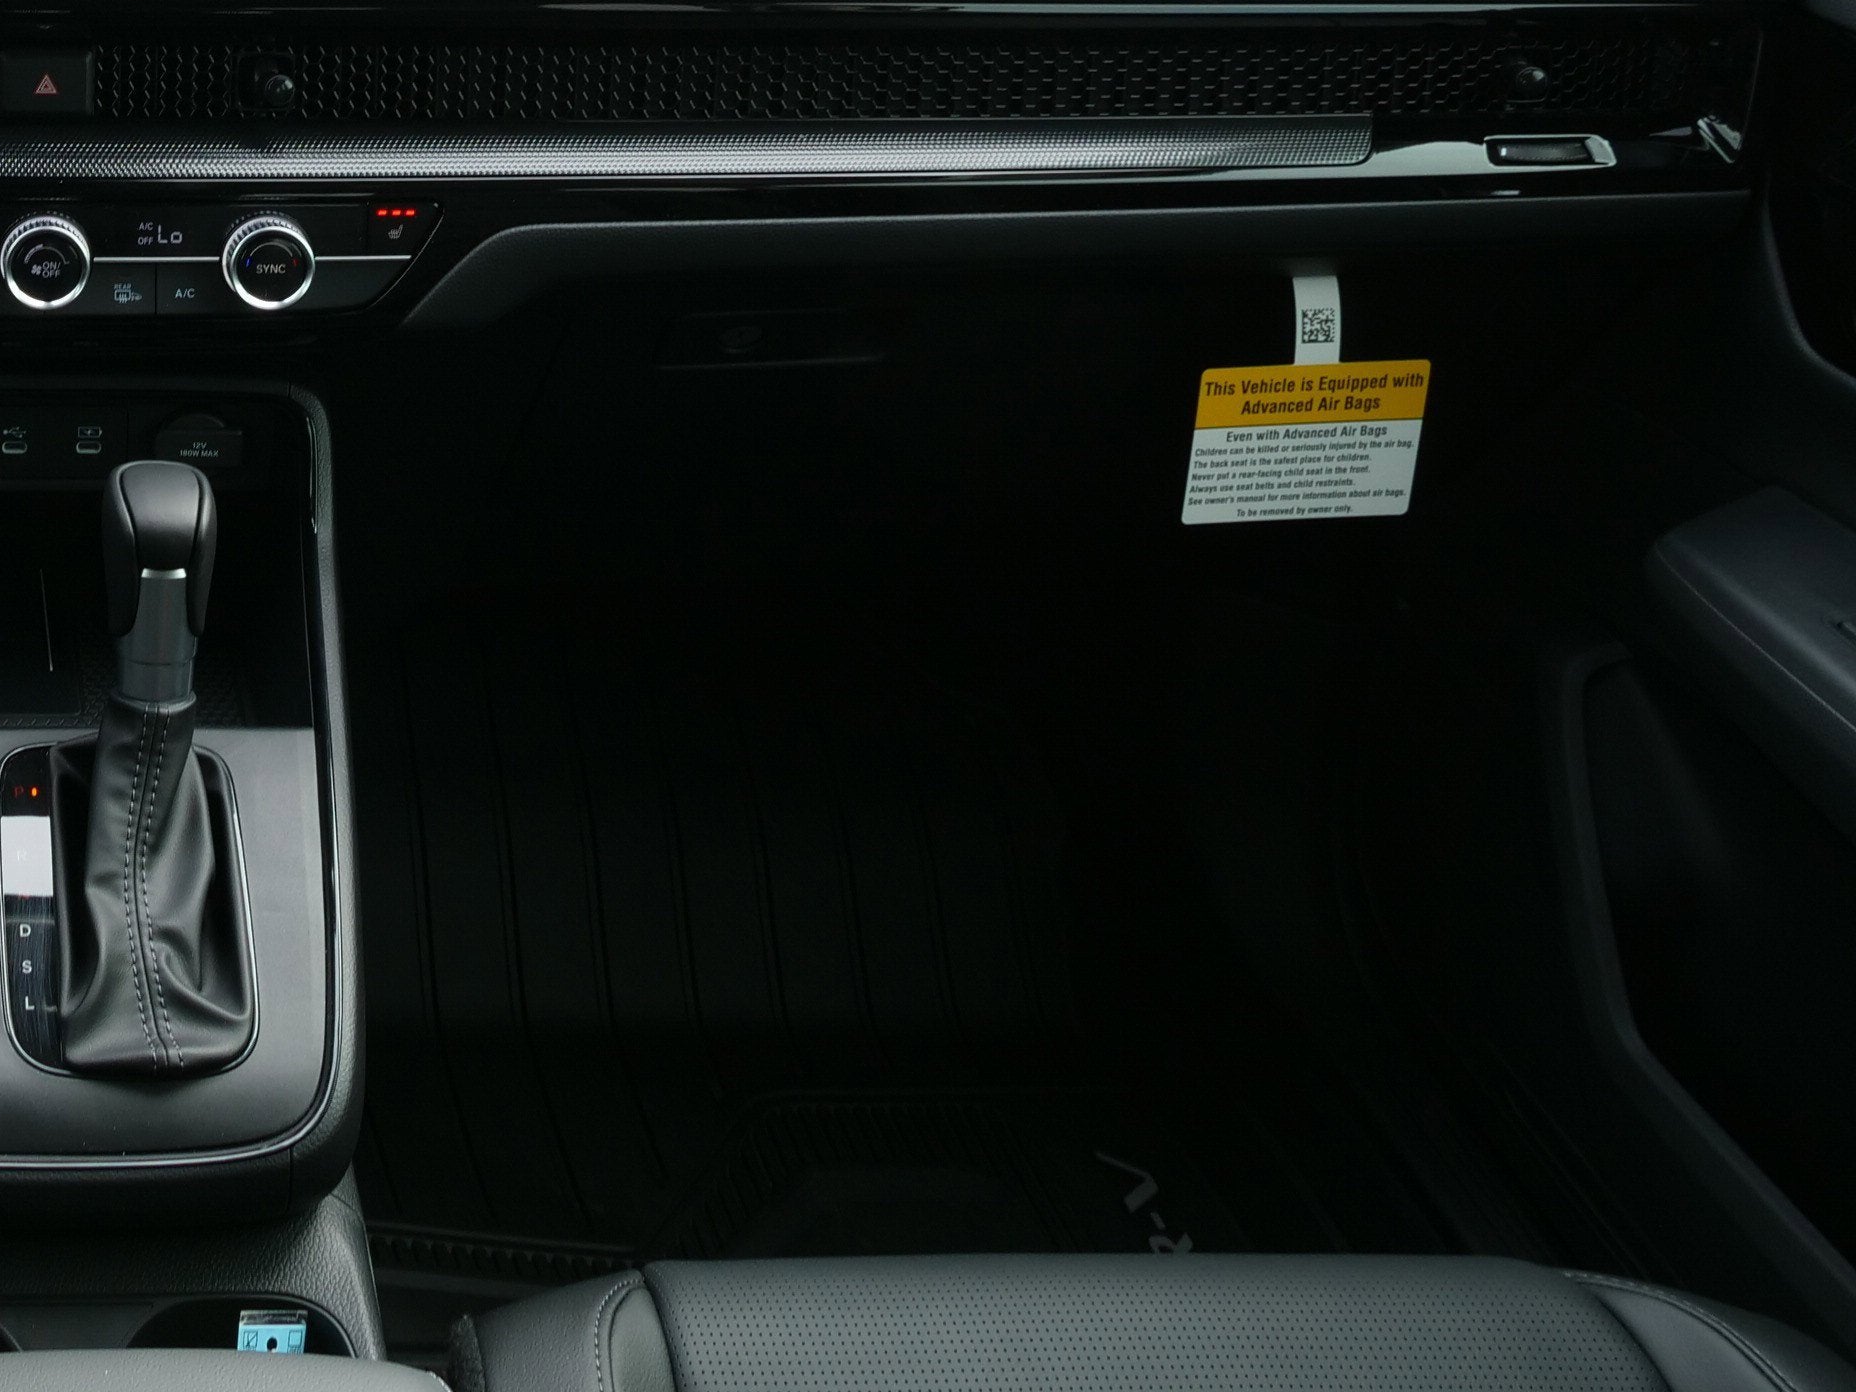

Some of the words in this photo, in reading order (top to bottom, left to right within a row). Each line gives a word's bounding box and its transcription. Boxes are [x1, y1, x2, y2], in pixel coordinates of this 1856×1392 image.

[139, 222, 153, 231] A/C
[138, 237, 153, 246] OFF
[42, 269, 60, 278] OFF
[256, 263, 286, 274] SYNC
[175, 288, 195, 299] A/C
[1205, 381, 1235, 396] This
[1242, 377, 1295, 394] Vehicle
[1301, 378, 1313, 392] is
[1319, 374, 1387, 392] Equipped
[1392, 373, 1423, 388] with
[1241, 400, 1312, 415] Advanced
[1318, 398, 1340, 411] Air
[1345, 396, 1380, 410] Bags
[1227, 432, 1252, 442] Even
[1257, 430, 1279, 440] with
[1283, 426, 1337, 439] Advanced
[1341, 426, 1357, 436] Air
[1360, 425, 1387, 437] Bags
[192, 441, 207, 449] 12V
[1195, 448, 1227, 456] Children
[1292, 442, 1326, 452] seriously
[1329, 442, 1356, 451] injured
[1358, 441, 1368, 450] by
[1397, 440, 1414, 449] bag.
[201, 449, 219, 458] MAX
[1194, 461, 1207, 469] The
[1210, 460, 1228, 468] back
[1274, 457, 1298, 465] safest
[1300, 455, 1321, 464] place
[1337, 454, 1372, 462] children.
[1217, 472, 1230, 480] put
[1239, 470, 1282, 479] rear-facing
[1284, 468, 1304, 476] child
[1306, 467, 1323, 475] seat
[1335, 466, 1348, 474] the
[1349, 465, 1370, 473] front.
[1189, 485, 1217, 493] Always
[1236, 483, 1254, 491] seat
[1255, 482, 1274, 490] belts
[1294, 479, 1313, 487] child
[1315, 478, 1356, 487] restraints.
[1188, 497, 1202, 505] See
[1236, 495, 1265, 503] manual
[1302, 491, 1346, 499] information
[1348, 489, 1371, 497] about
[1385, 489, 1406, 498] bags.
[1237, 509, 1245, 517] To
[1259, 507, 1294, 516] removed
[1334, 505, 1354, 513] only.
[20, 924, 31, 937] D
[22, 961, 31, 973] S
[25, 996, 34, 1010] L
